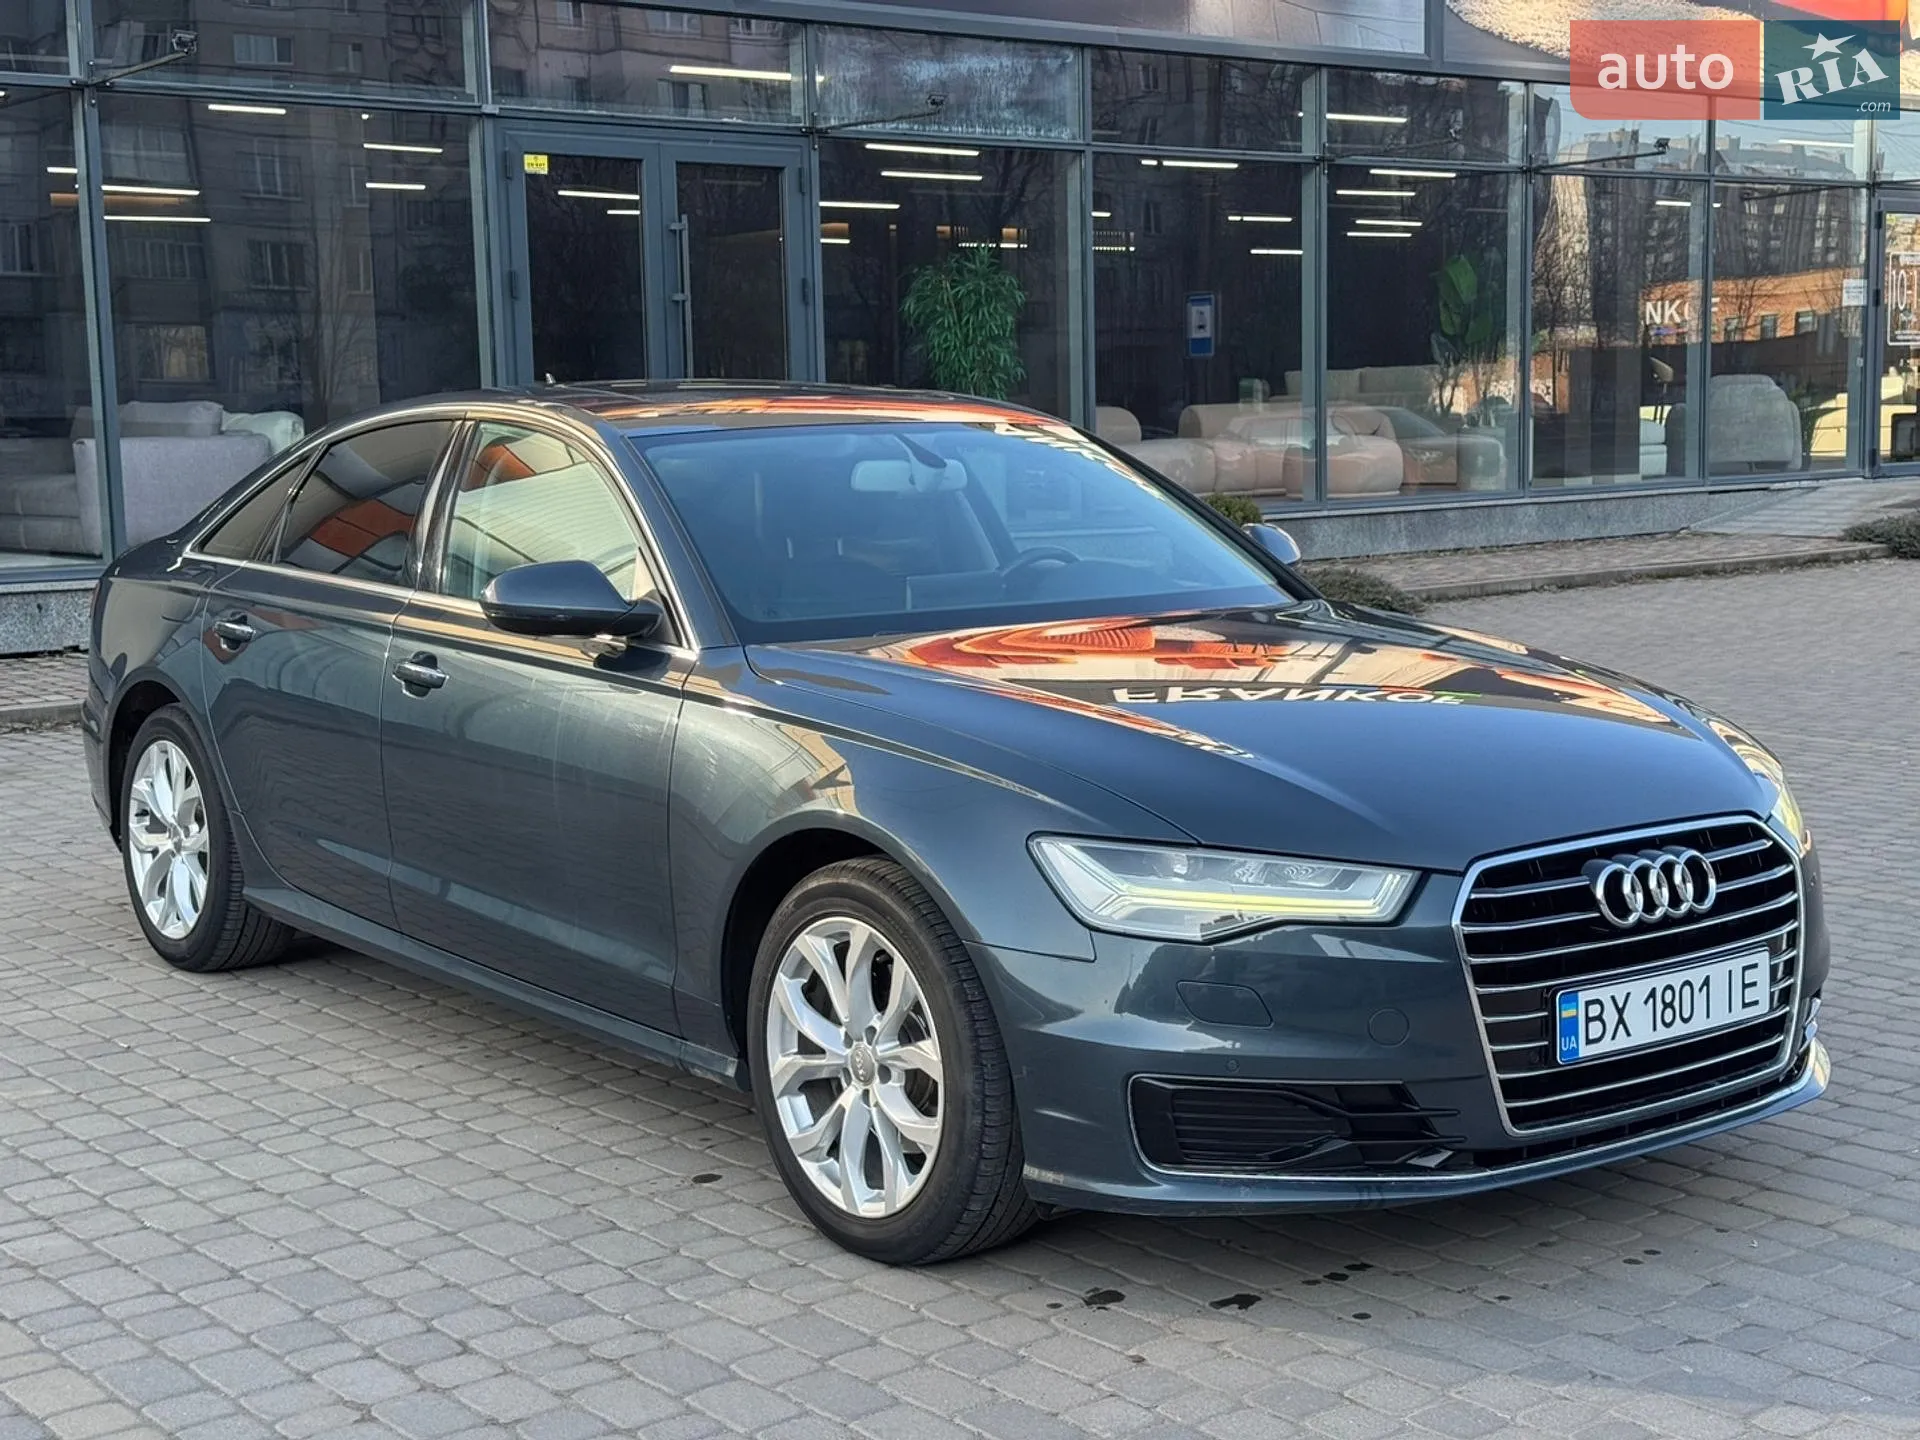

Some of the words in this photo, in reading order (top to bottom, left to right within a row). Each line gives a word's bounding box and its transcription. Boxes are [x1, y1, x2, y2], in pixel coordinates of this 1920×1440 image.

[1584, 992, 1632, 1046] BX
[1643, 974, 1711, 1032] 1801
[1727, 962, 1760, 1014] IE
[1561, 1036, 1578, 1051] UA
